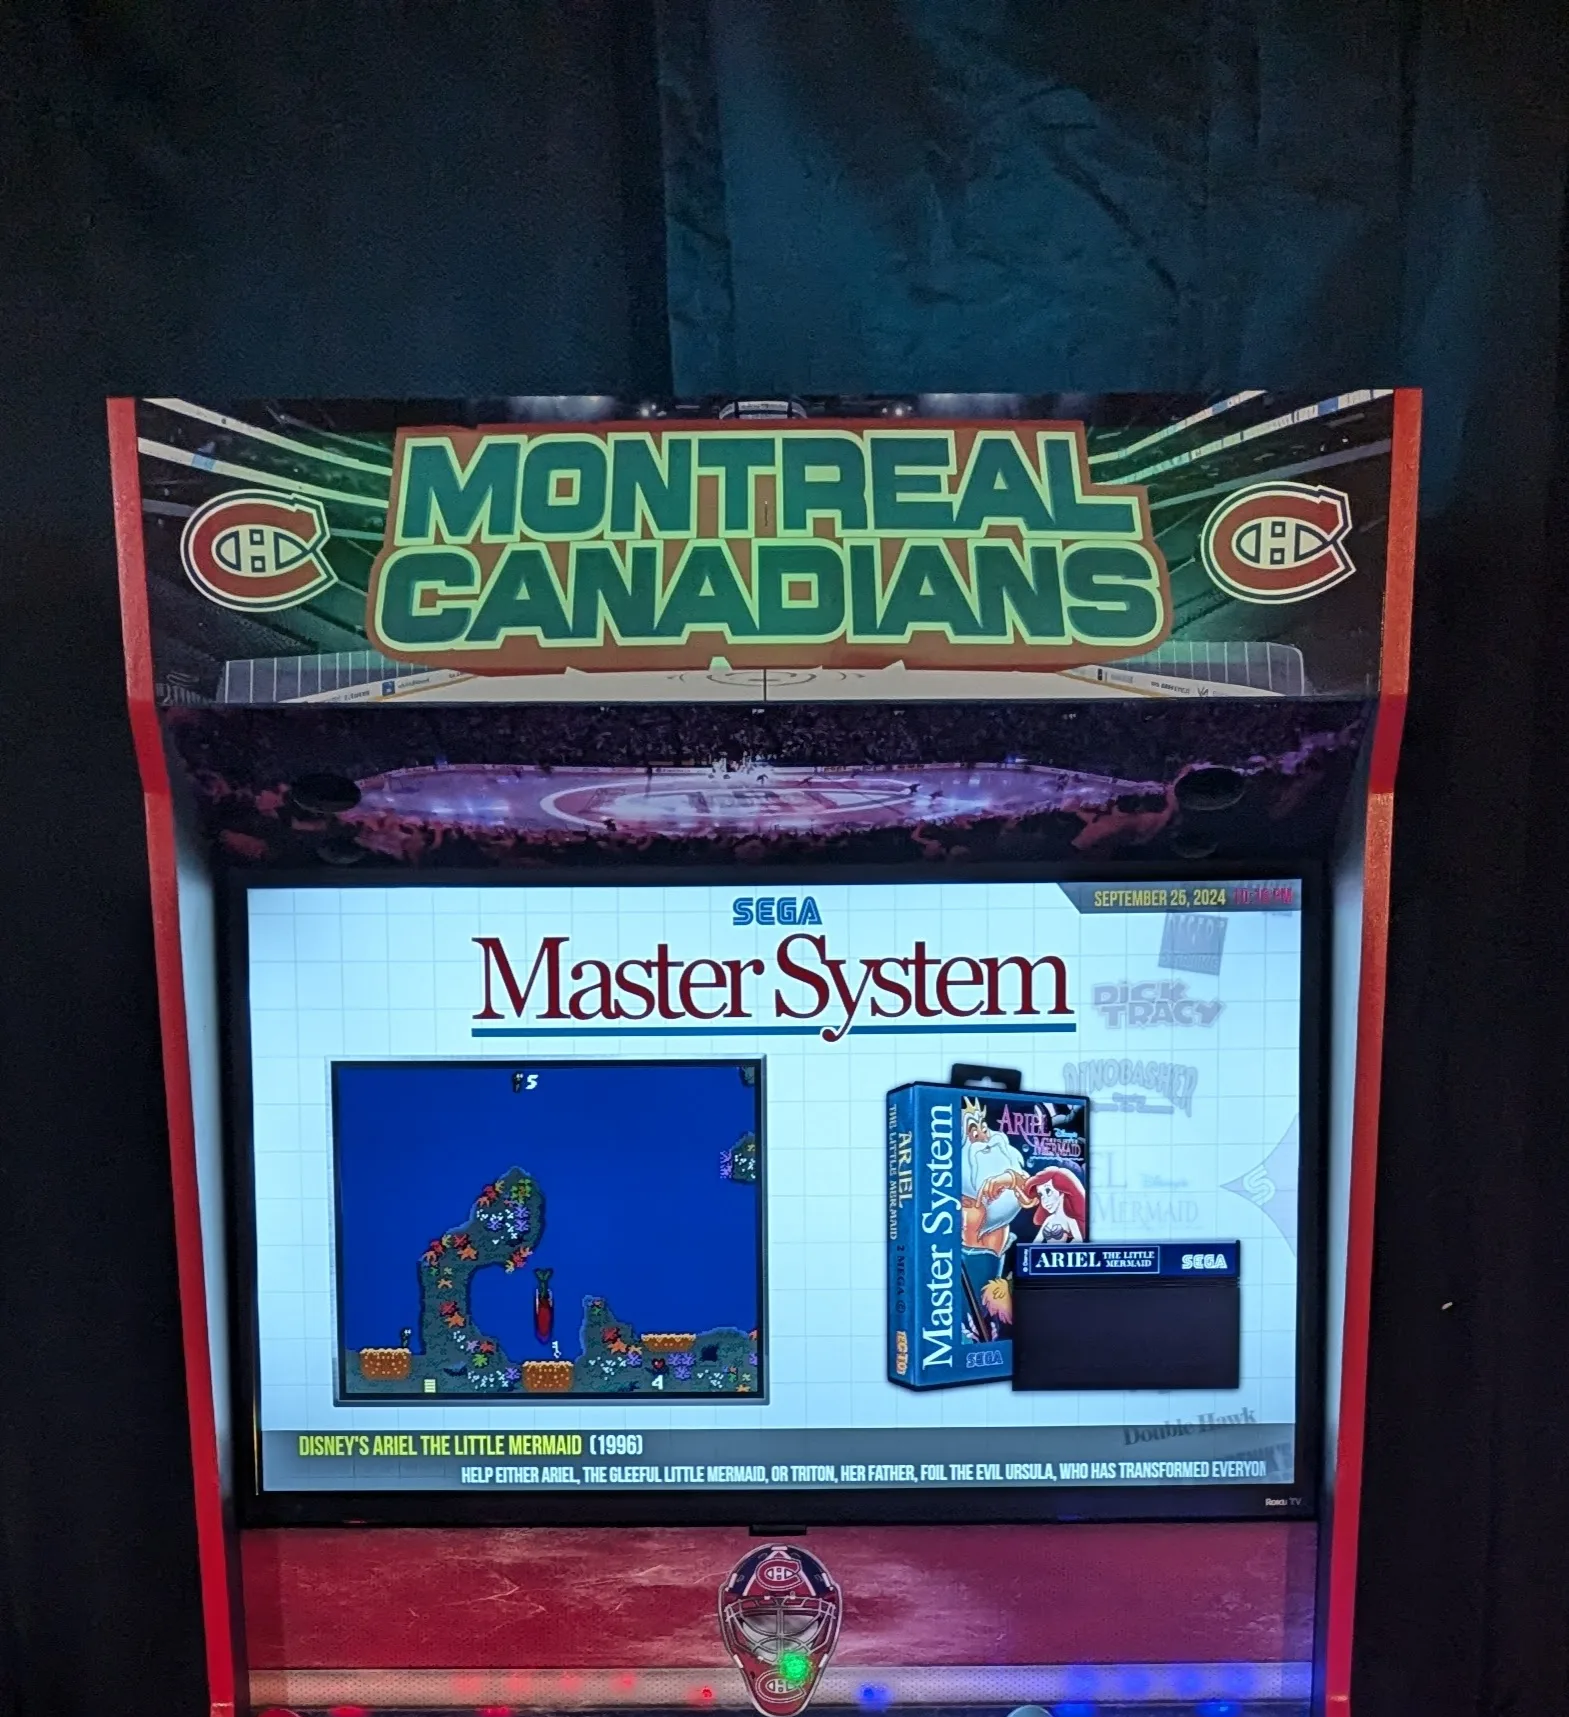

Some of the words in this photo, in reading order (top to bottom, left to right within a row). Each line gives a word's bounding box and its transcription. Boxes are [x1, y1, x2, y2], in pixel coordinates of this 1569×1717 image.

[394, 430, 1143, 546] MONTREAL
[375, 537, 1164, 652] CANADIANS
[1094, 889, 1168, 907] SEPTEMBER
[1193, 888, 1227, 906] 2024
[732, 896, 823, 926] SEGA
[471, 936, 765, 1021] Master
[775, 933, 1076, 1043] System
[1101, 1000, 1226, 1029] TRACY
[525, 1074, 539, 1090] 5
[898, 1131, 913, 1209] ARIEL
[922, 1103, 962, 1235] System
[1035, 1251, 1102, 1268] ARIEL
[1102, 1252, 1122, 1260] THE
[1123, 1251, 1155, 1260] LITTLE
[1105, 1259, 1152, 1268] MERMAID
[1181, 1254, 1228, 1270] SEGA
[922, 1244, 953, 1370] Master
[966, 1350, 1004, 1369] SEGA
[651, 1374, 664, 1390] 4
[1122, 1418, 1195, 1446] Double
[1197, 1406, 1258, 1434] Hawk
[299, 1435, 369, 1456] DISNEY'S
[372, 1435, 418, 1456] ARIEL
[420, 1435, 451, 1456] THE
[454, 1435, 505, 1456] LITTLE
[508, 1434, 582, 1456] MERMAID
[589, 1434, 643, 1455] (1996)
[461, 1466, 494, 1484] HELP
[495, 1466, 540, 1484] EITHER
[541, 1466, 581, 1485] ARIEL,
[582, 1466, 608, 1483] THE
[609, 1466, 663, 1483] GLEEFUL
[664, 1466, 705, 1483] LITTLE
[706, 1465, 769, 1484] MERMAID,
[771, 1465, 789, 1482] OR
[790, 1465, 839, 1484] TRITON,
[841, 1465, 866, 1482] HER
[868, 1464, 919, 1483] FATHER,
[920, 1464, 948, 1482] FOIL
[949, 1463, 974, 1481] THE
[975, 1463, 1004, 1481] EVIL
[1005, 1463, 1058, 1482] URSULA,
[1060, 1462, 1090, 1480] WHO
[1091, 1462, 1116, 1479] HAS
[1118, 1461, 1209, 1479] TRANSFORMED
